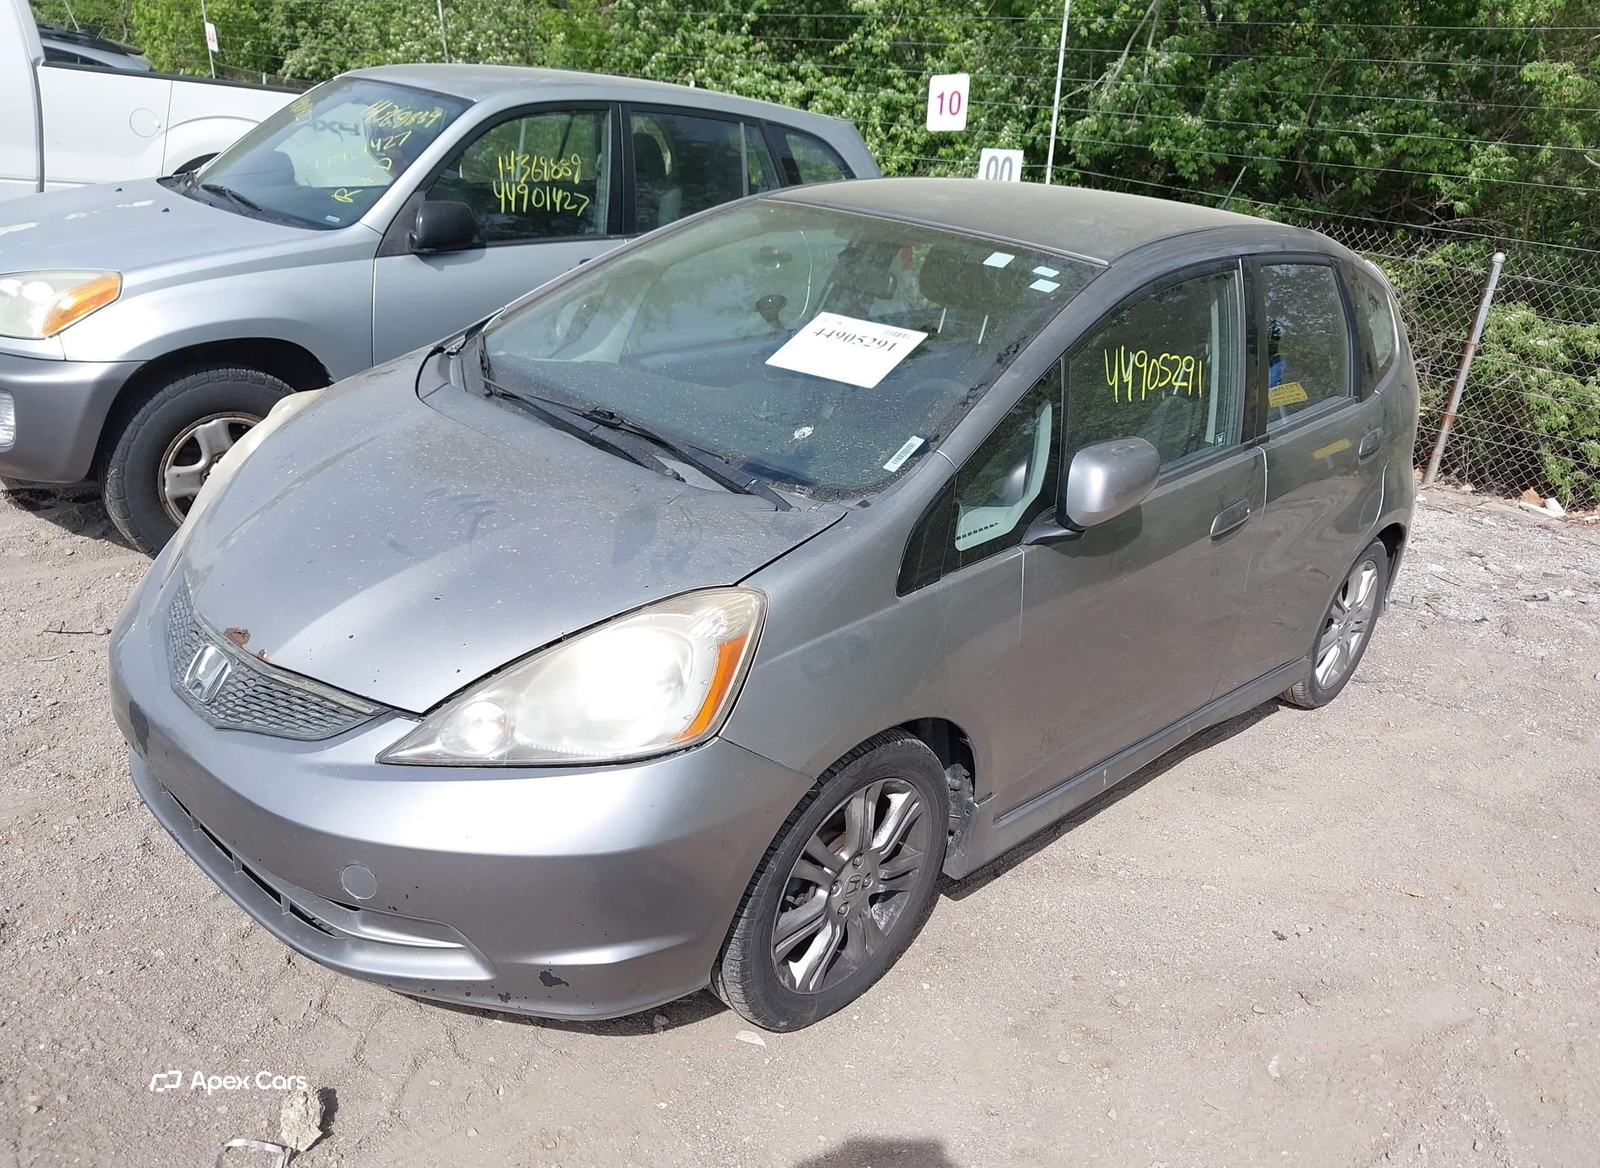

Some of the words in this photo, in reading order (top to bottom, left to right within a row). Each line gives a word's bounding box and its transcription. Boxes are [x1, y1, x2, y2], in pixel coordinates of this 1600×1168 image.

[936, 90, 962, 116] 10
[493, 181, 590, 217] 44901427
[813, 328, 898, 352] 44905291
[1104, 344, 1203, 404] 44905291
